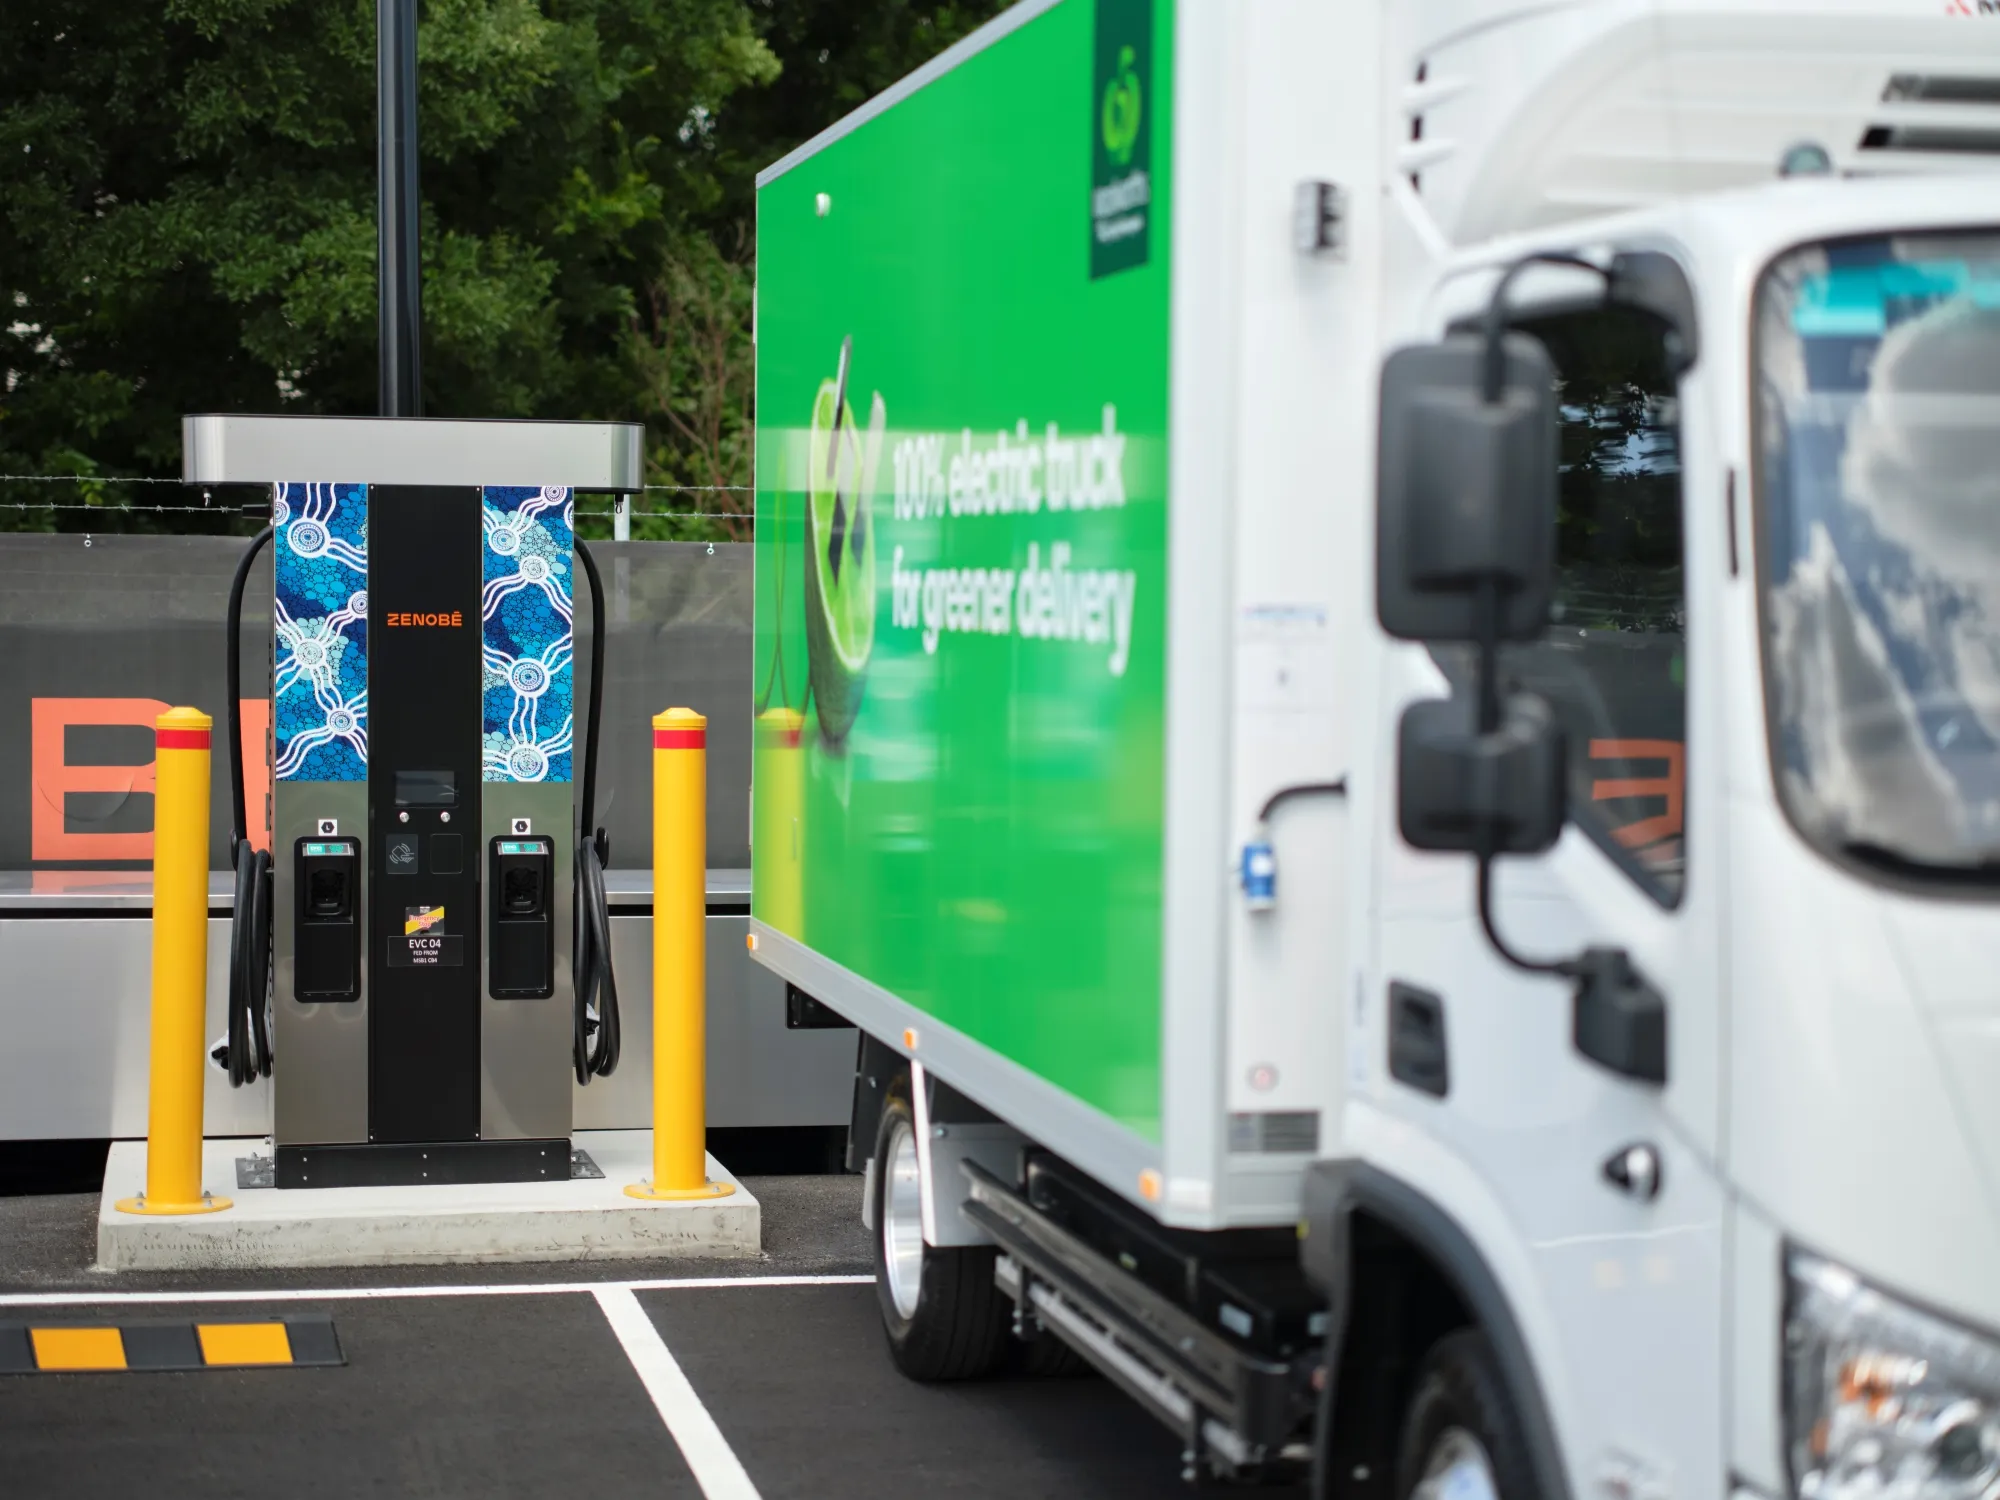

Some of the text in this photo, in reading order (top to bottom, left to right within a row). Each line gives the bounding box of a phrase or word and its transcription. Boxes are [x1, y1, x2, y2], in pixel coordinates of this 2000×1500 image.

[892, 402, 1126, 521] 100% electric truck
[892, 541, 1136, 676] for greener delivery
[409, 939, 441, 948] EVC 04
